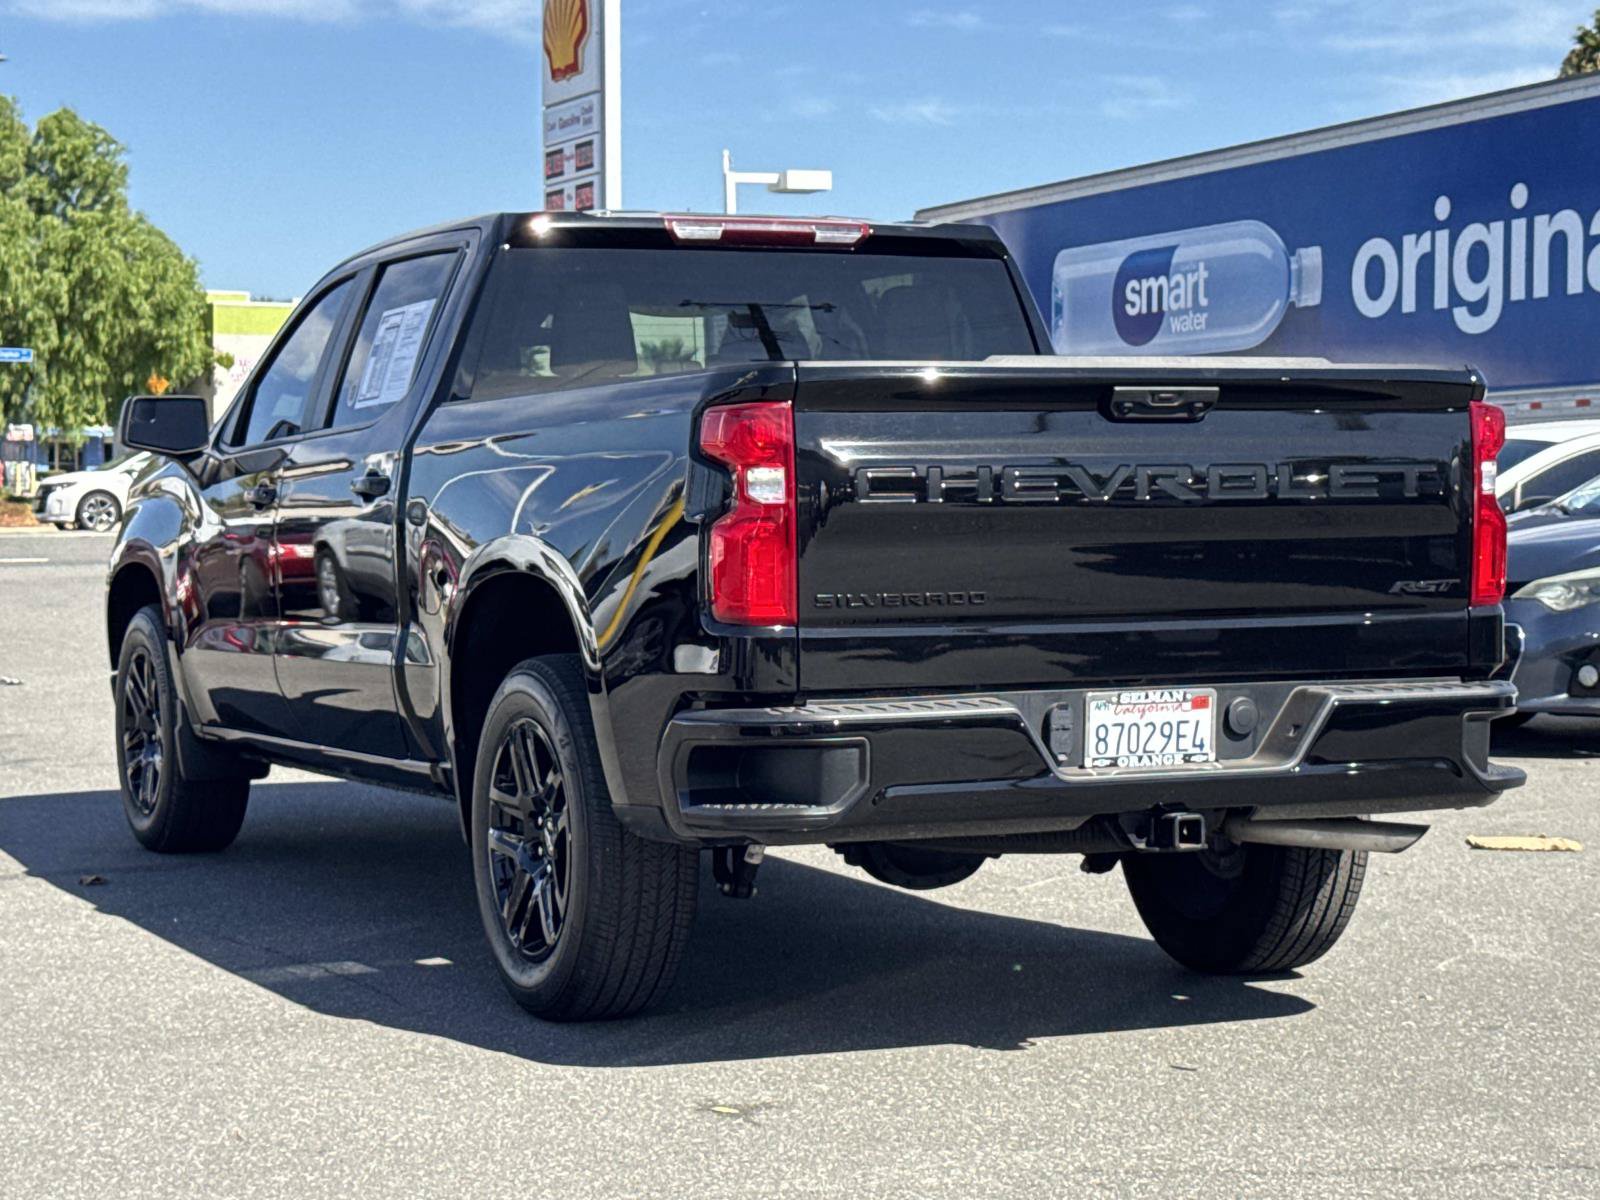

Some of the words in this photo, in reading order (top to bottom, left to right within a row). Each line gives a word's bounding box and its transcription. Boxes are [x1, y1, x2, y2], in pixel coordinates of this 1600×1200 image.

[1124, 262, 1208, 316] smart
[1169, 309, 1208, 333] water
[855, 464, 1437, 502] CHEVROLET
[1388, 578, 1461, 593] RST
[814, 591, 988, 609] SILVERADO
[1095, 720, 1205, 755] 87029E4
[1116, 754, 1184, 768] ORANGE
